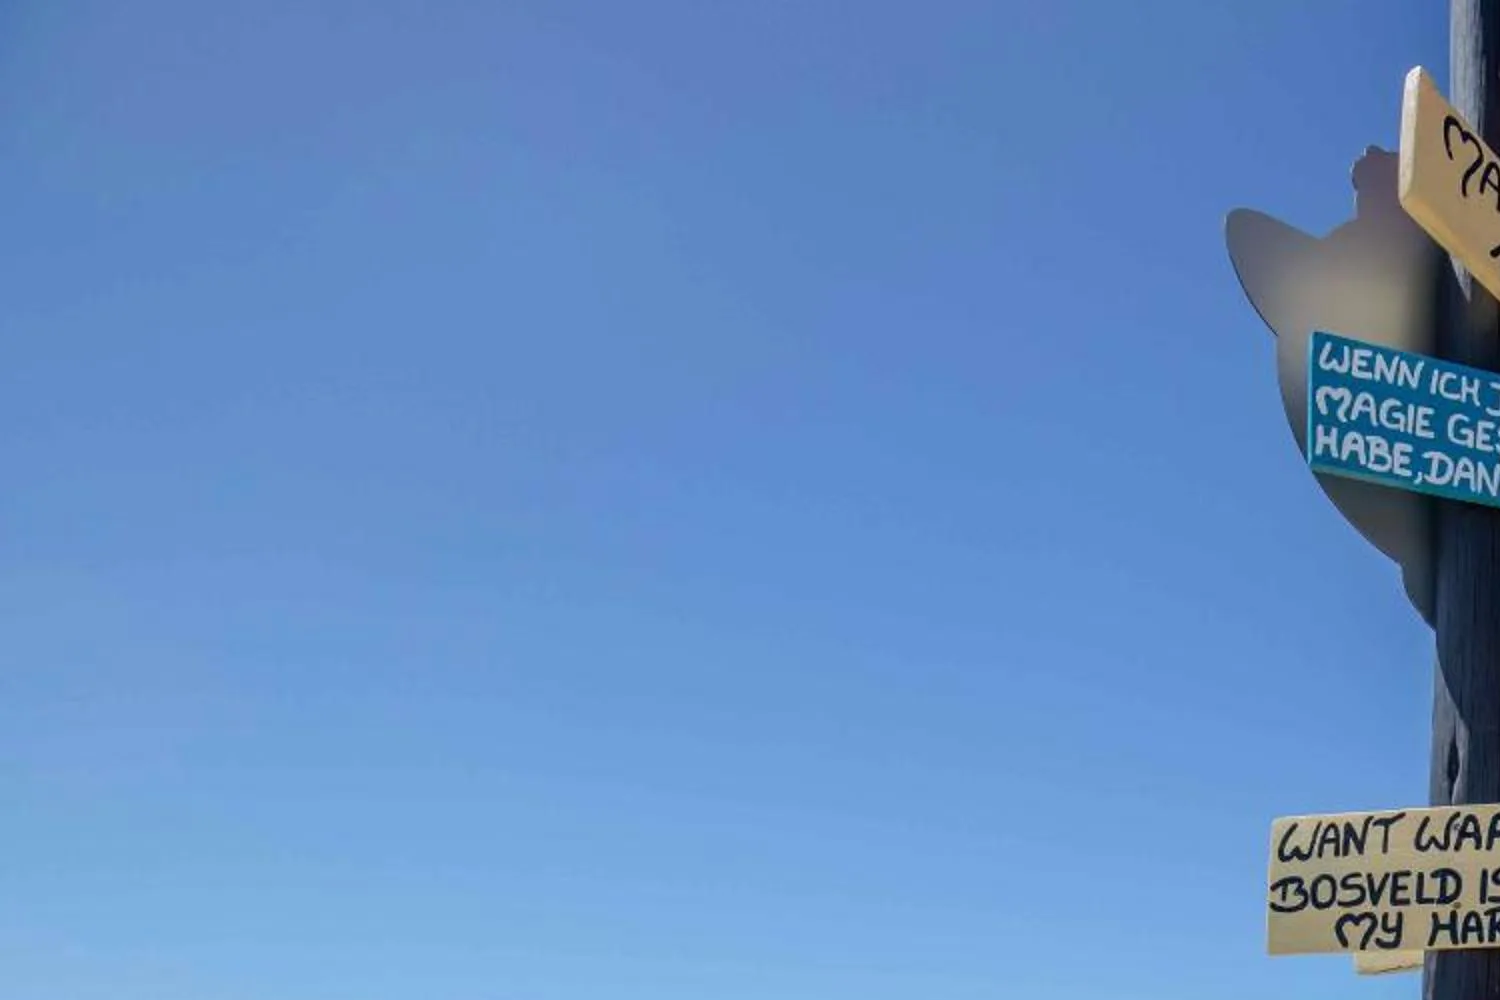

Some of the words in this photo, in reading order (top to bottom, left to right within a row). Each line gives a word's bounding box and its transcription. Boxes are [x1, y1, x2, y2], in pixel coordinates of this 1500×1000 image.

[1320, 342, 1424, 388] WENN
[1431, 369, 1480, 407] ICH
[1315, 386, 1435, 439] MAGIE
[1277, 812, 1405, 863] WANT
[1269, 867, 1463, 913] BOSVELD
[1334, 911, 1403, 950] MY
